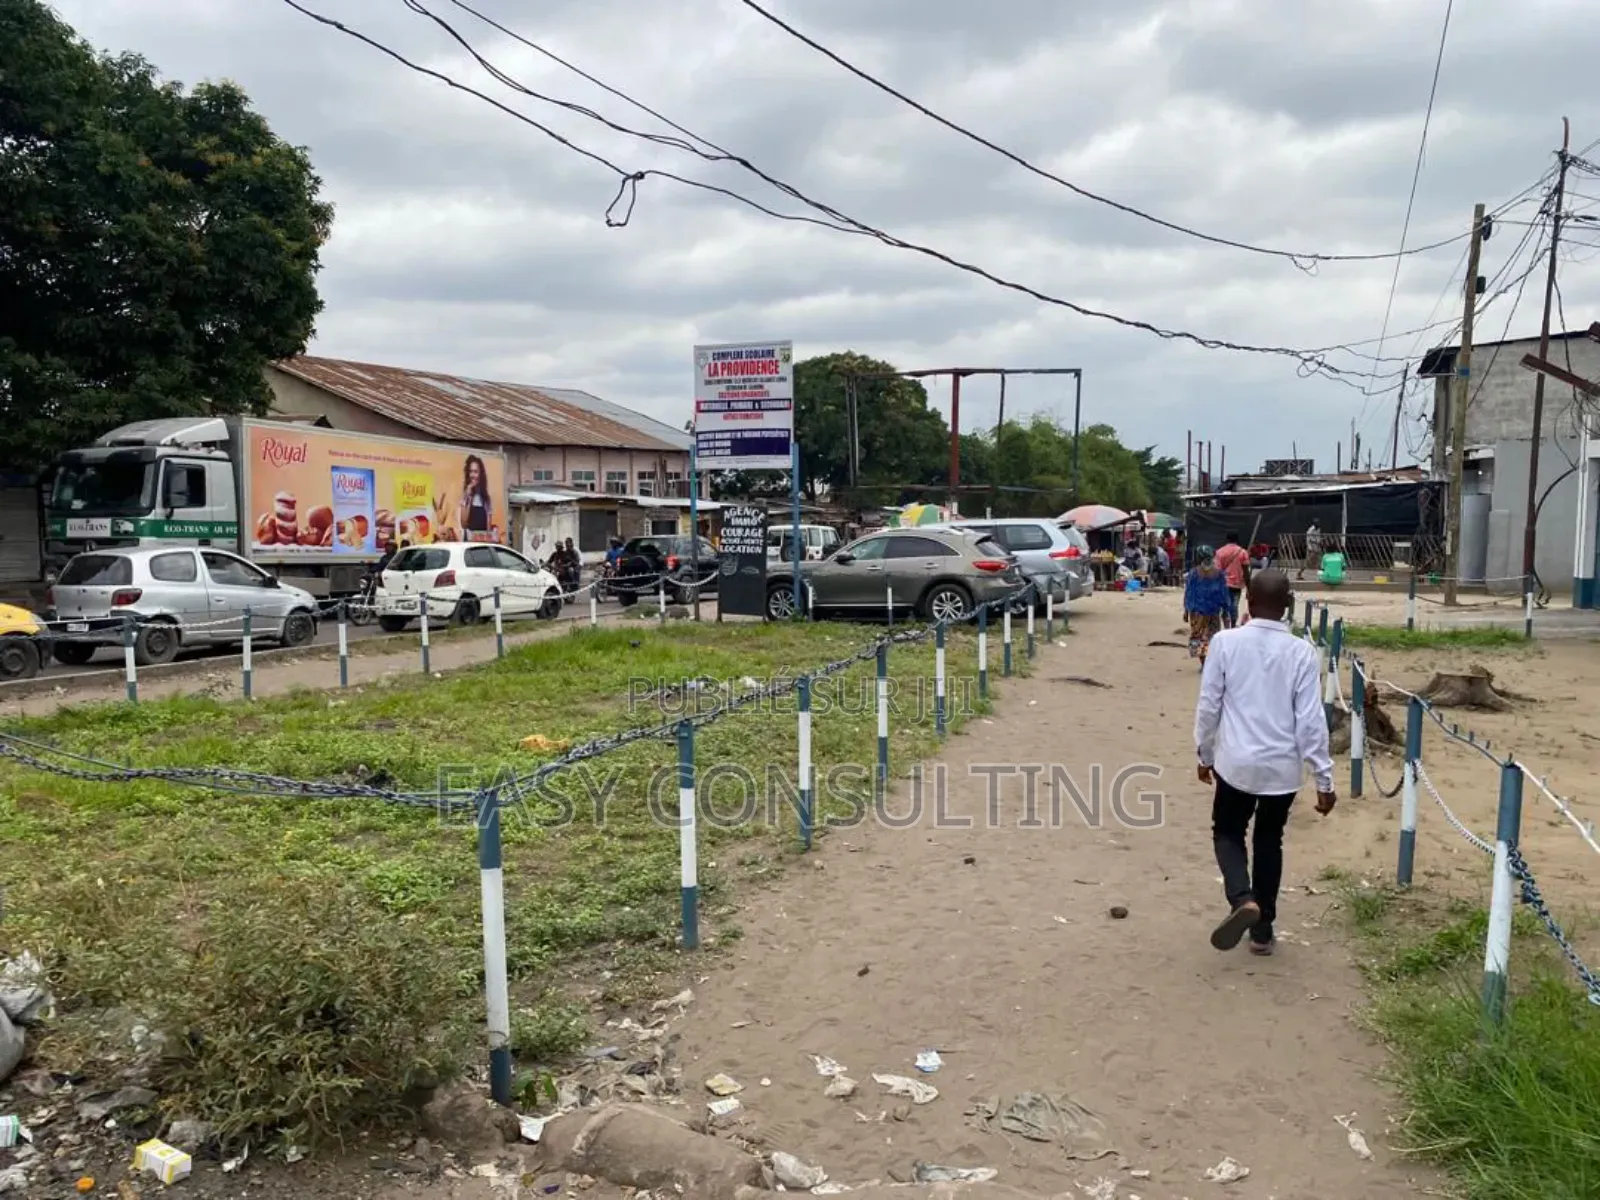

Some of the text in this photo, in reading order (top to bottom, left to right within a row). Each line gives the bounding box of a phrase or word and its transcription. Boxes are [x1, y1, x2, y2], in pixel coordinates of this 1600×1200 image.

[744, 349, 775, 359] SCOLAIRE
[708, 360, 780, 377] LA PROVIDENCE
[261, 437, 308, 468] Royal
[335, 472, 367, 494] Royal
[402, 480, 427, 499] Royal
[724, 506, 765, 523] AGENCE
[731, 517, 758, 526] IMMO
[164, 524, 209, 534] ECO-TRANS
[720, 527, 764, 537] COURAGE
[719, 545, 762, 553] LOCATION
